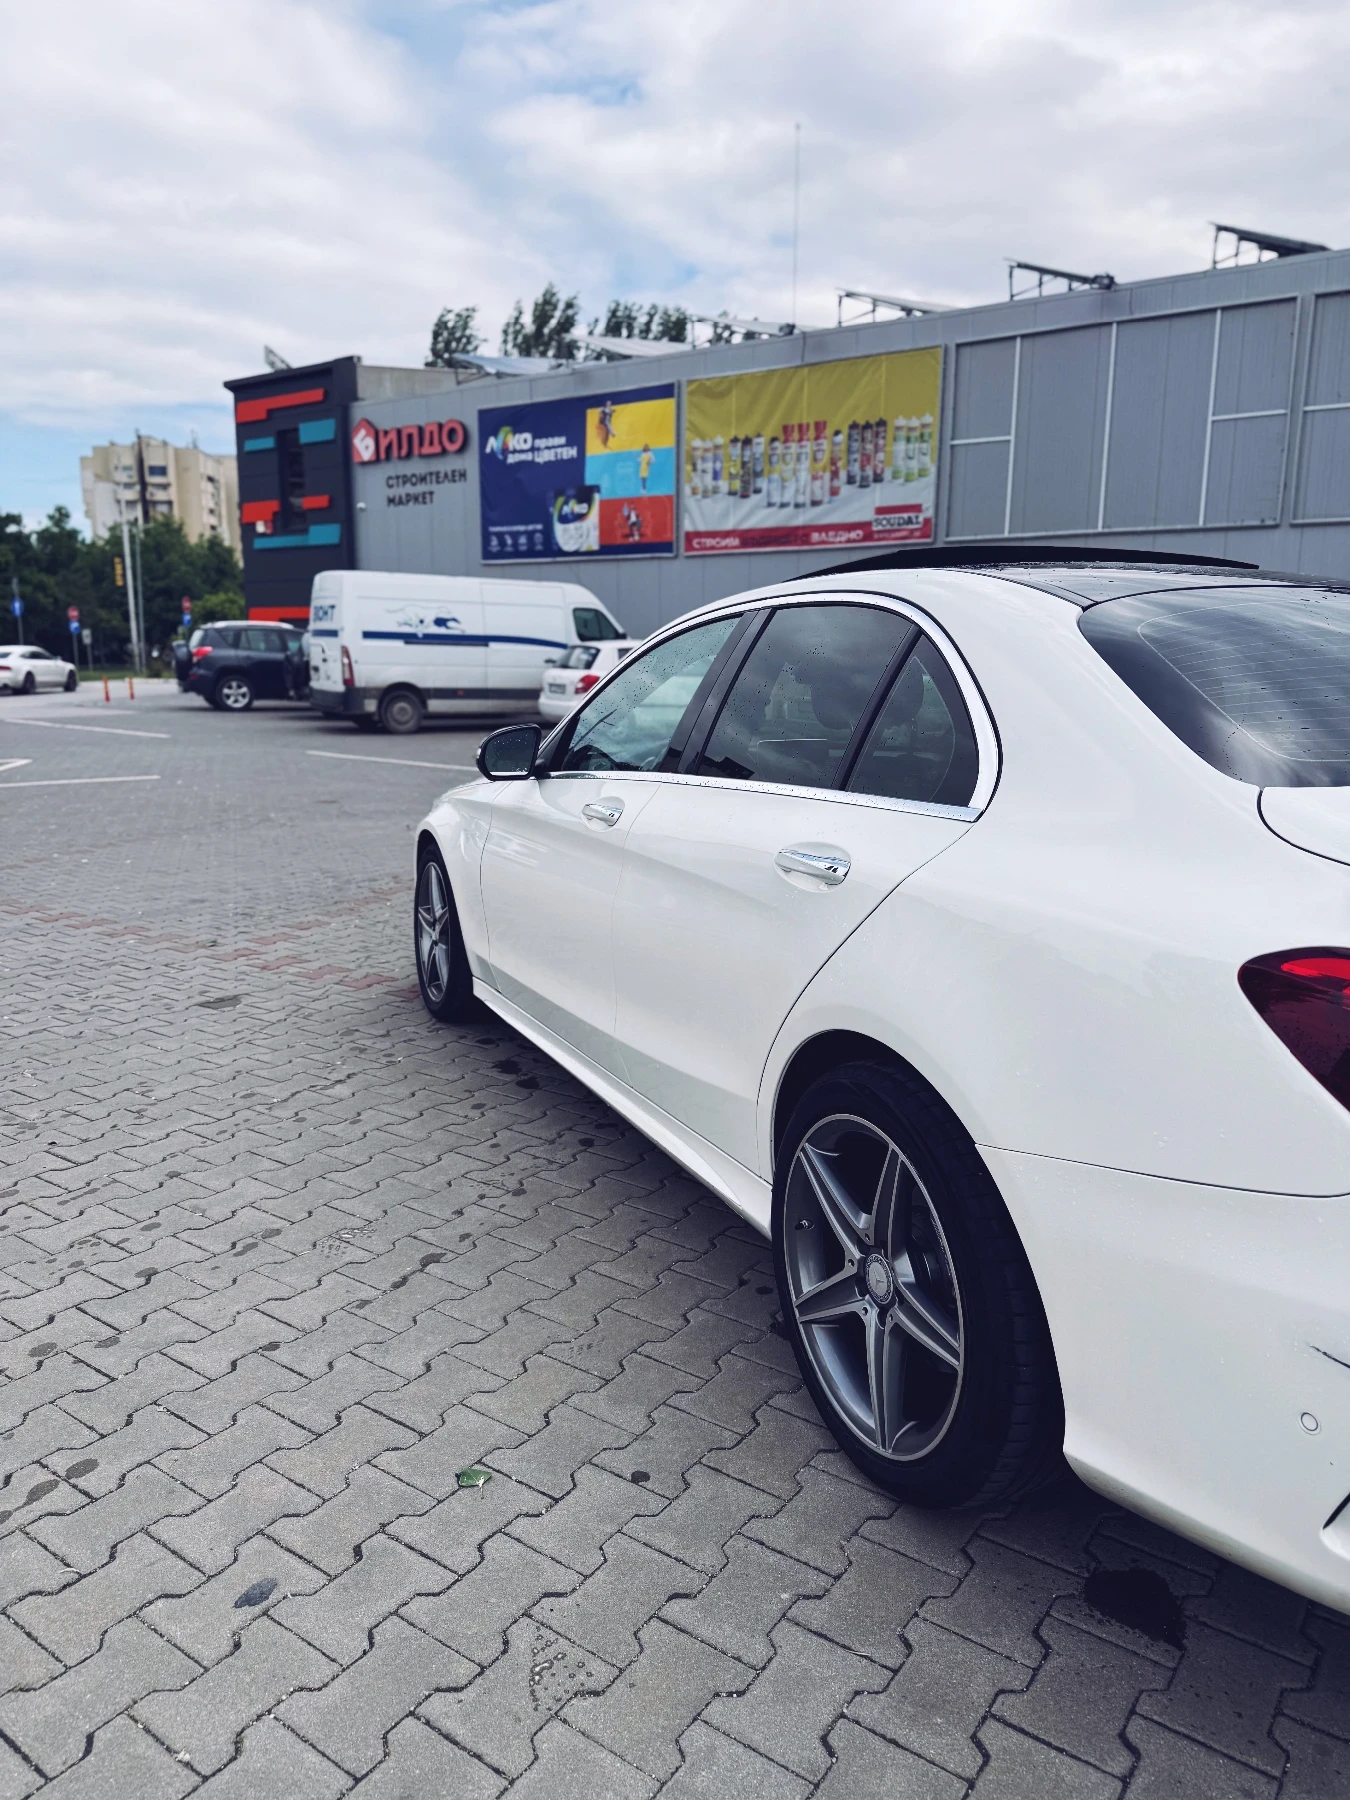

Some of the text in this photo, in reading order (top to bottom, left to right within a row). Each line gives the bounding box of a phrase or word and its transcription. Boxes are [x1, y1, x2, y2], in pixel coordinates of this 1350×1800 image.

[385, 468, 468, 488] СТРОИТЕЛЕН
[386, 491, 435, 507] МАРКЕТ
[873, 514, 921, 528] SOUDAL
